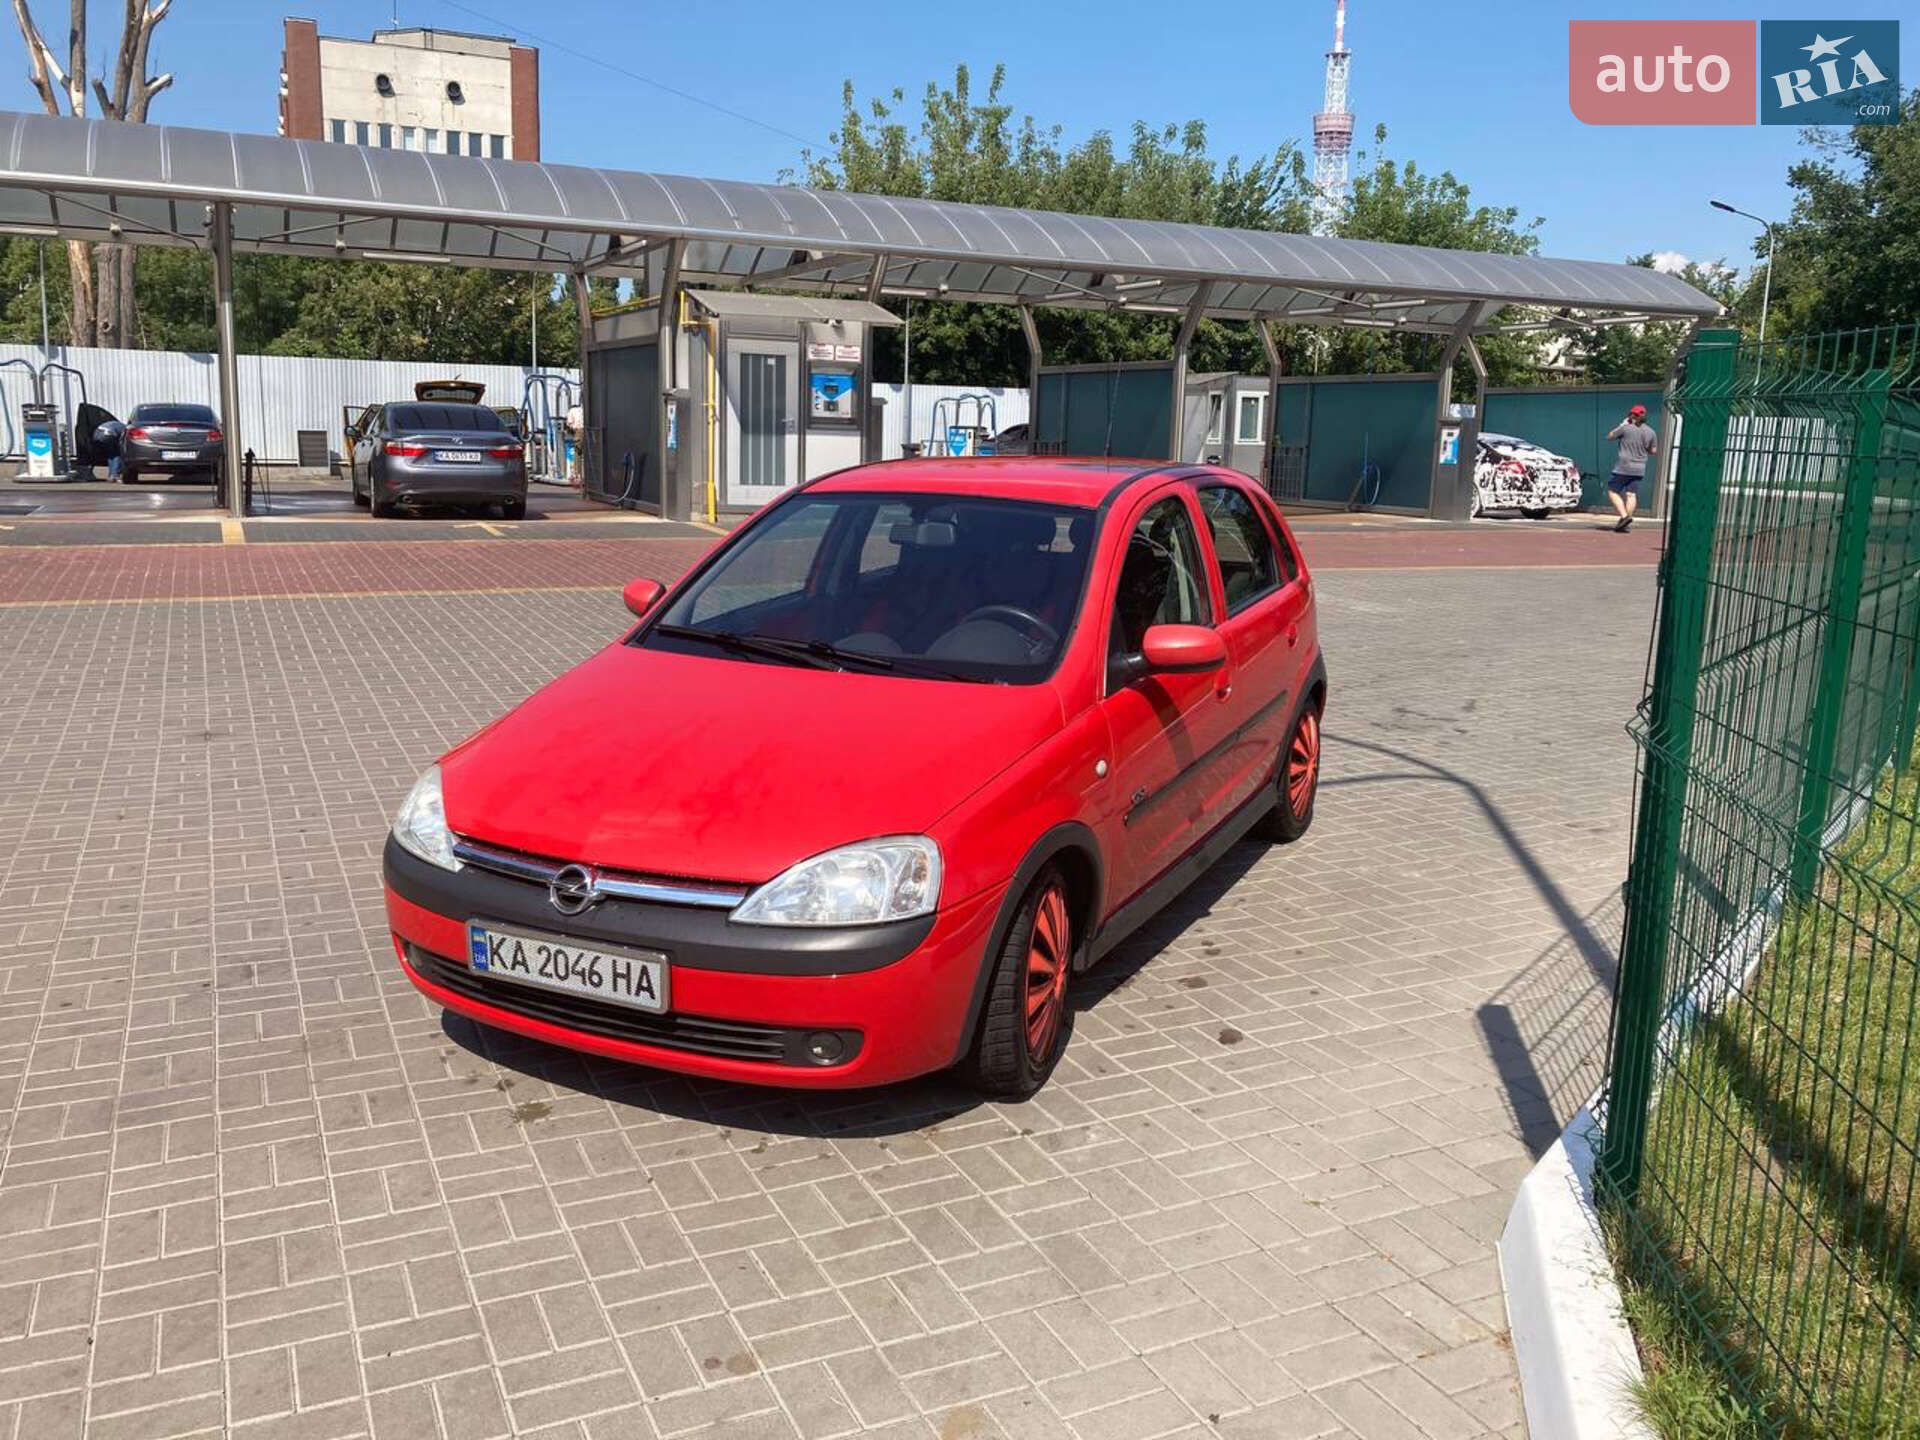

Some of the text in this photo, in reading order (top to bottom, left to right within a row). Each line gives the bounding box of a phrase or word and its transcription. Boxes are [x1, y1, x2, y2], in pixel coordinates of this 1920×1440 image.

[489, 934, 657, 1000] KA 2046 HA
